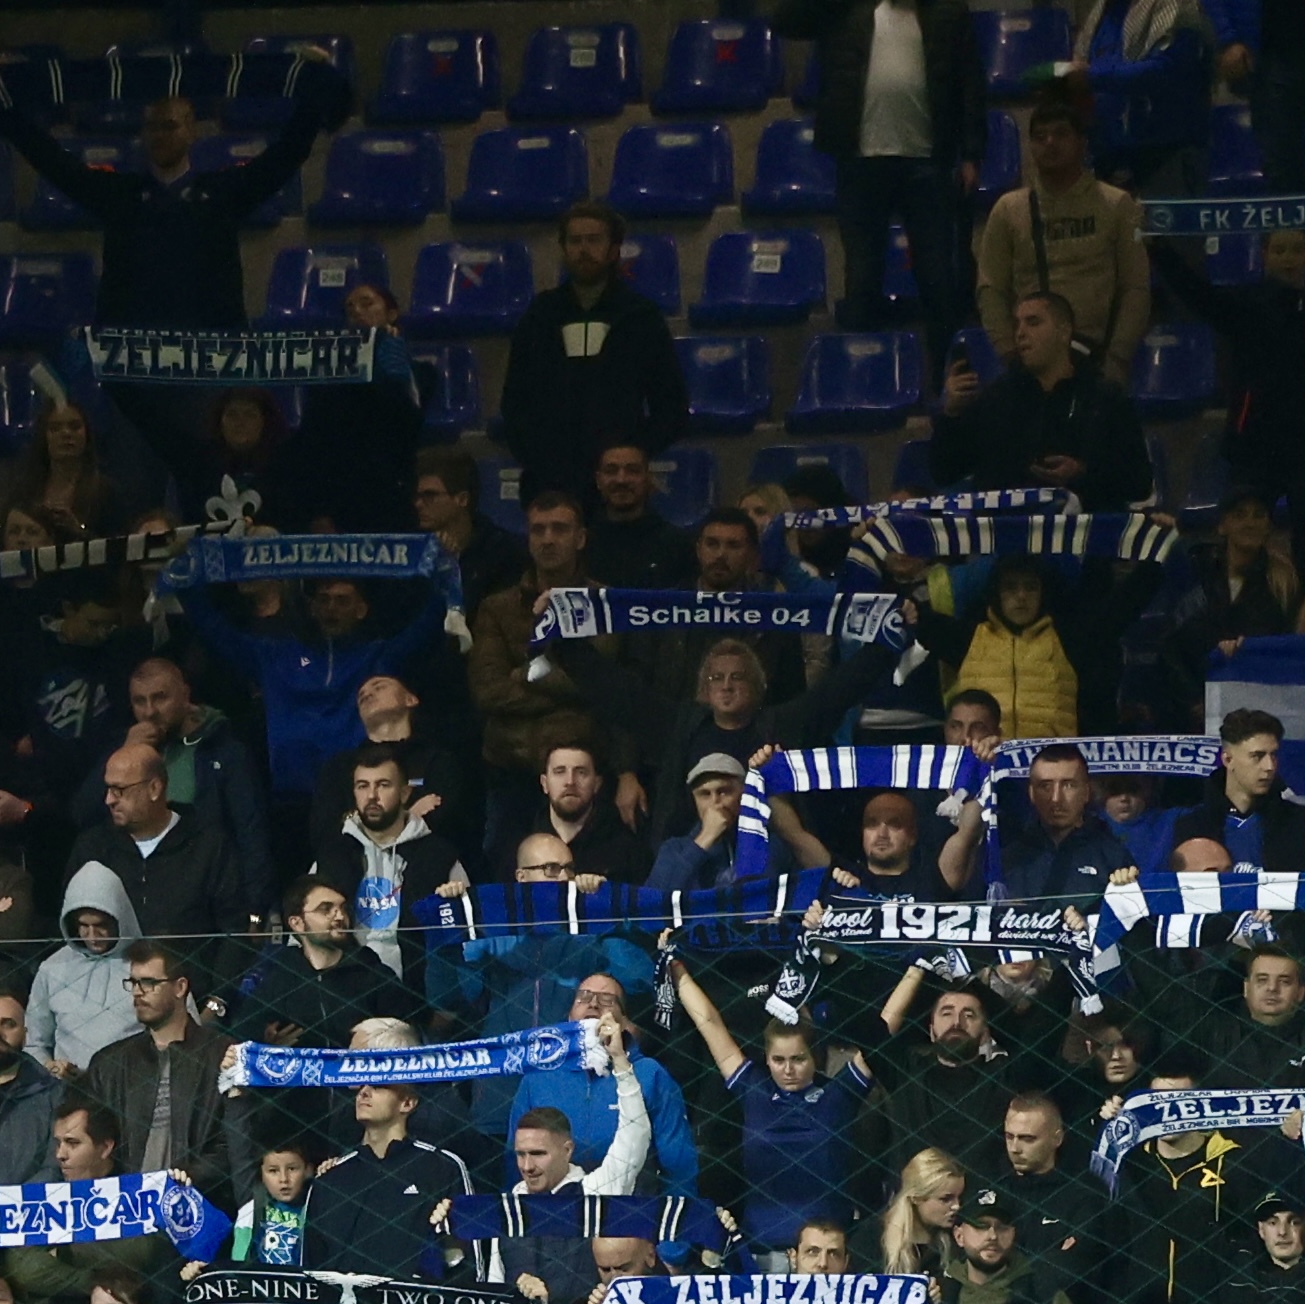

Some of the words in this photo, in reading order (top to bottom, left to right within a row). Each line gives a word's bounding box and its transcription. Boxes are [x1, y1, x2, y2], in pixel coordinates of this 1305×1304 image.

[1199, 208, 1230, 230] FK
[628, 604, 761, 627] Schalke
[771, 605, 811, 627] 04
[358, 896, 399, 911] NASA
[880, 903, 992, 942] 1921
[999, 906, 1062, 931] hard
[186, 1279, 320, 1303] ONE-NINE
